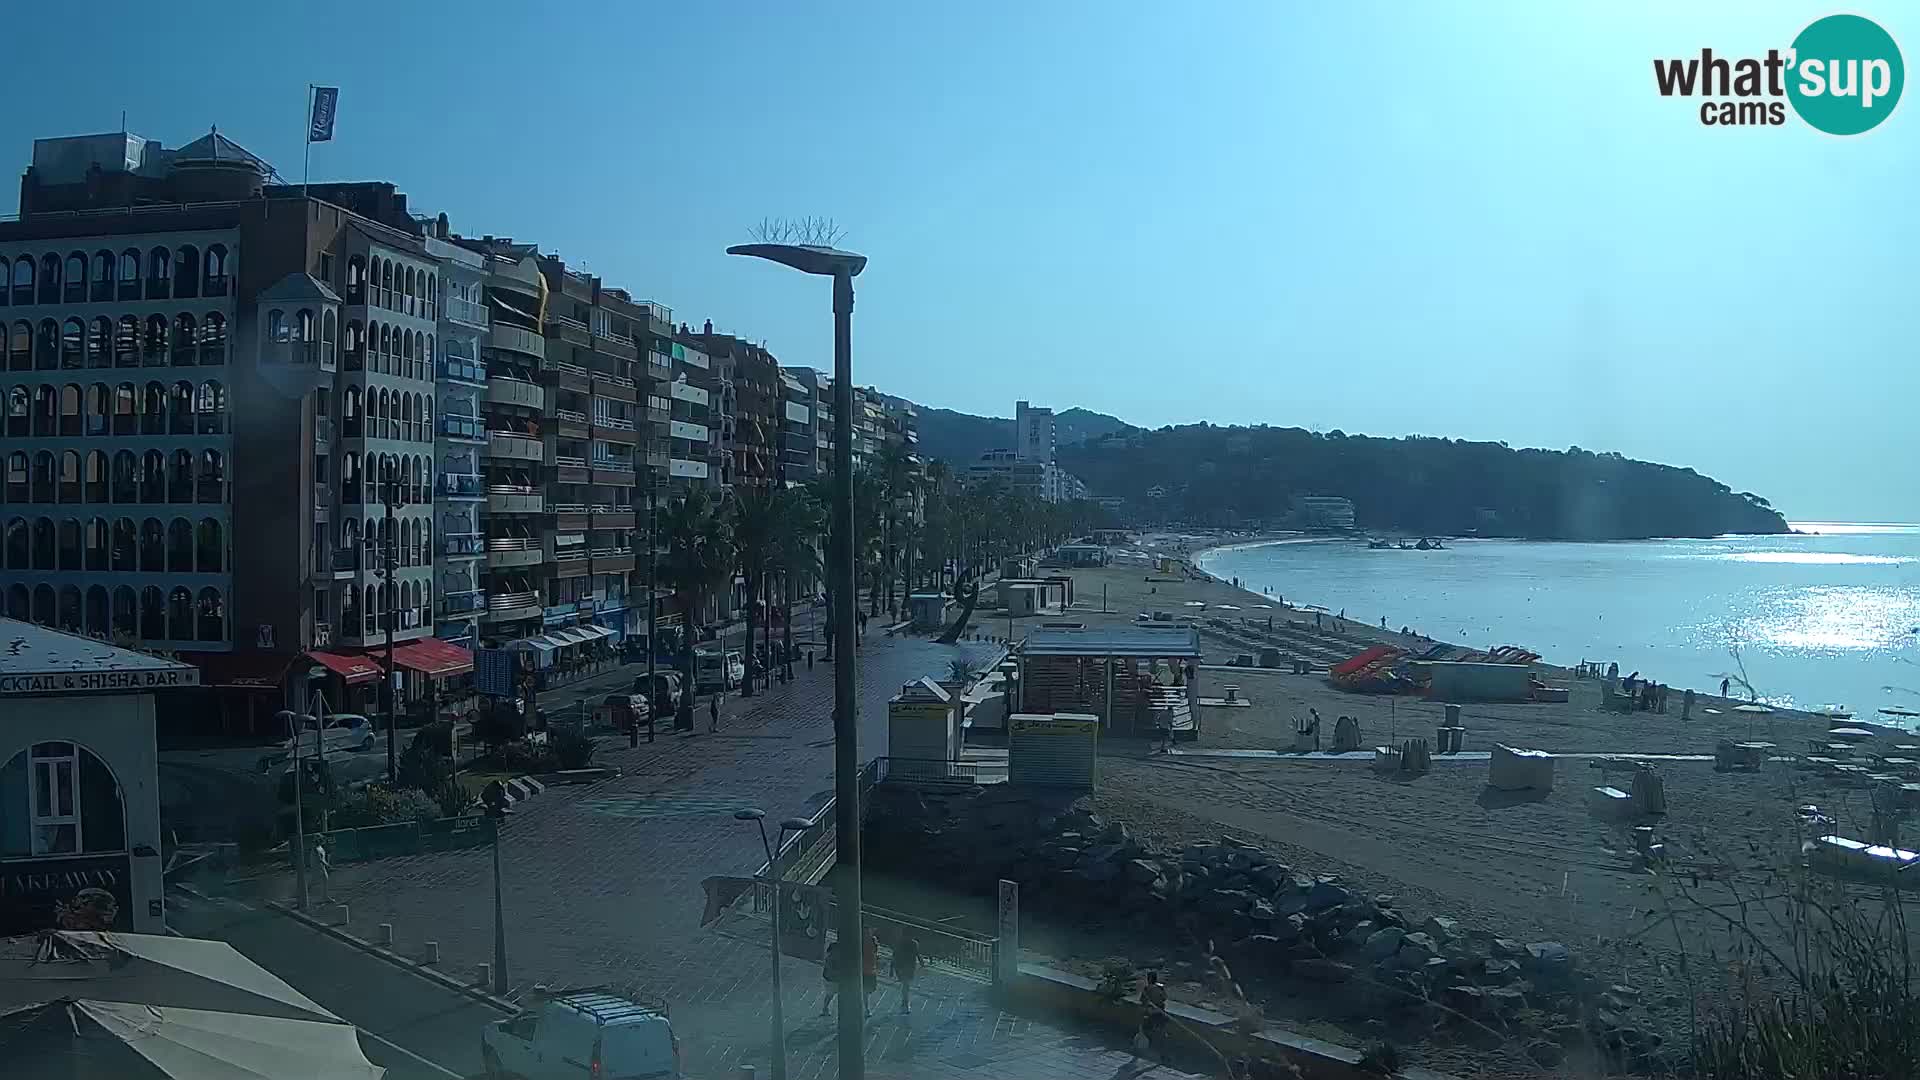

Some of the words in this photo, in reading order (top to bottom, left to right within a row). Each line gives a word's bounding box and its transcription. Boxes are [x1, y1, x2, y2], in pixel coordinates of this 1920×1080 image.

[63, 675, 74, 689] &
[80, 673, 142, 689] SHISHA
[146, 672, 178, 686] BAR
